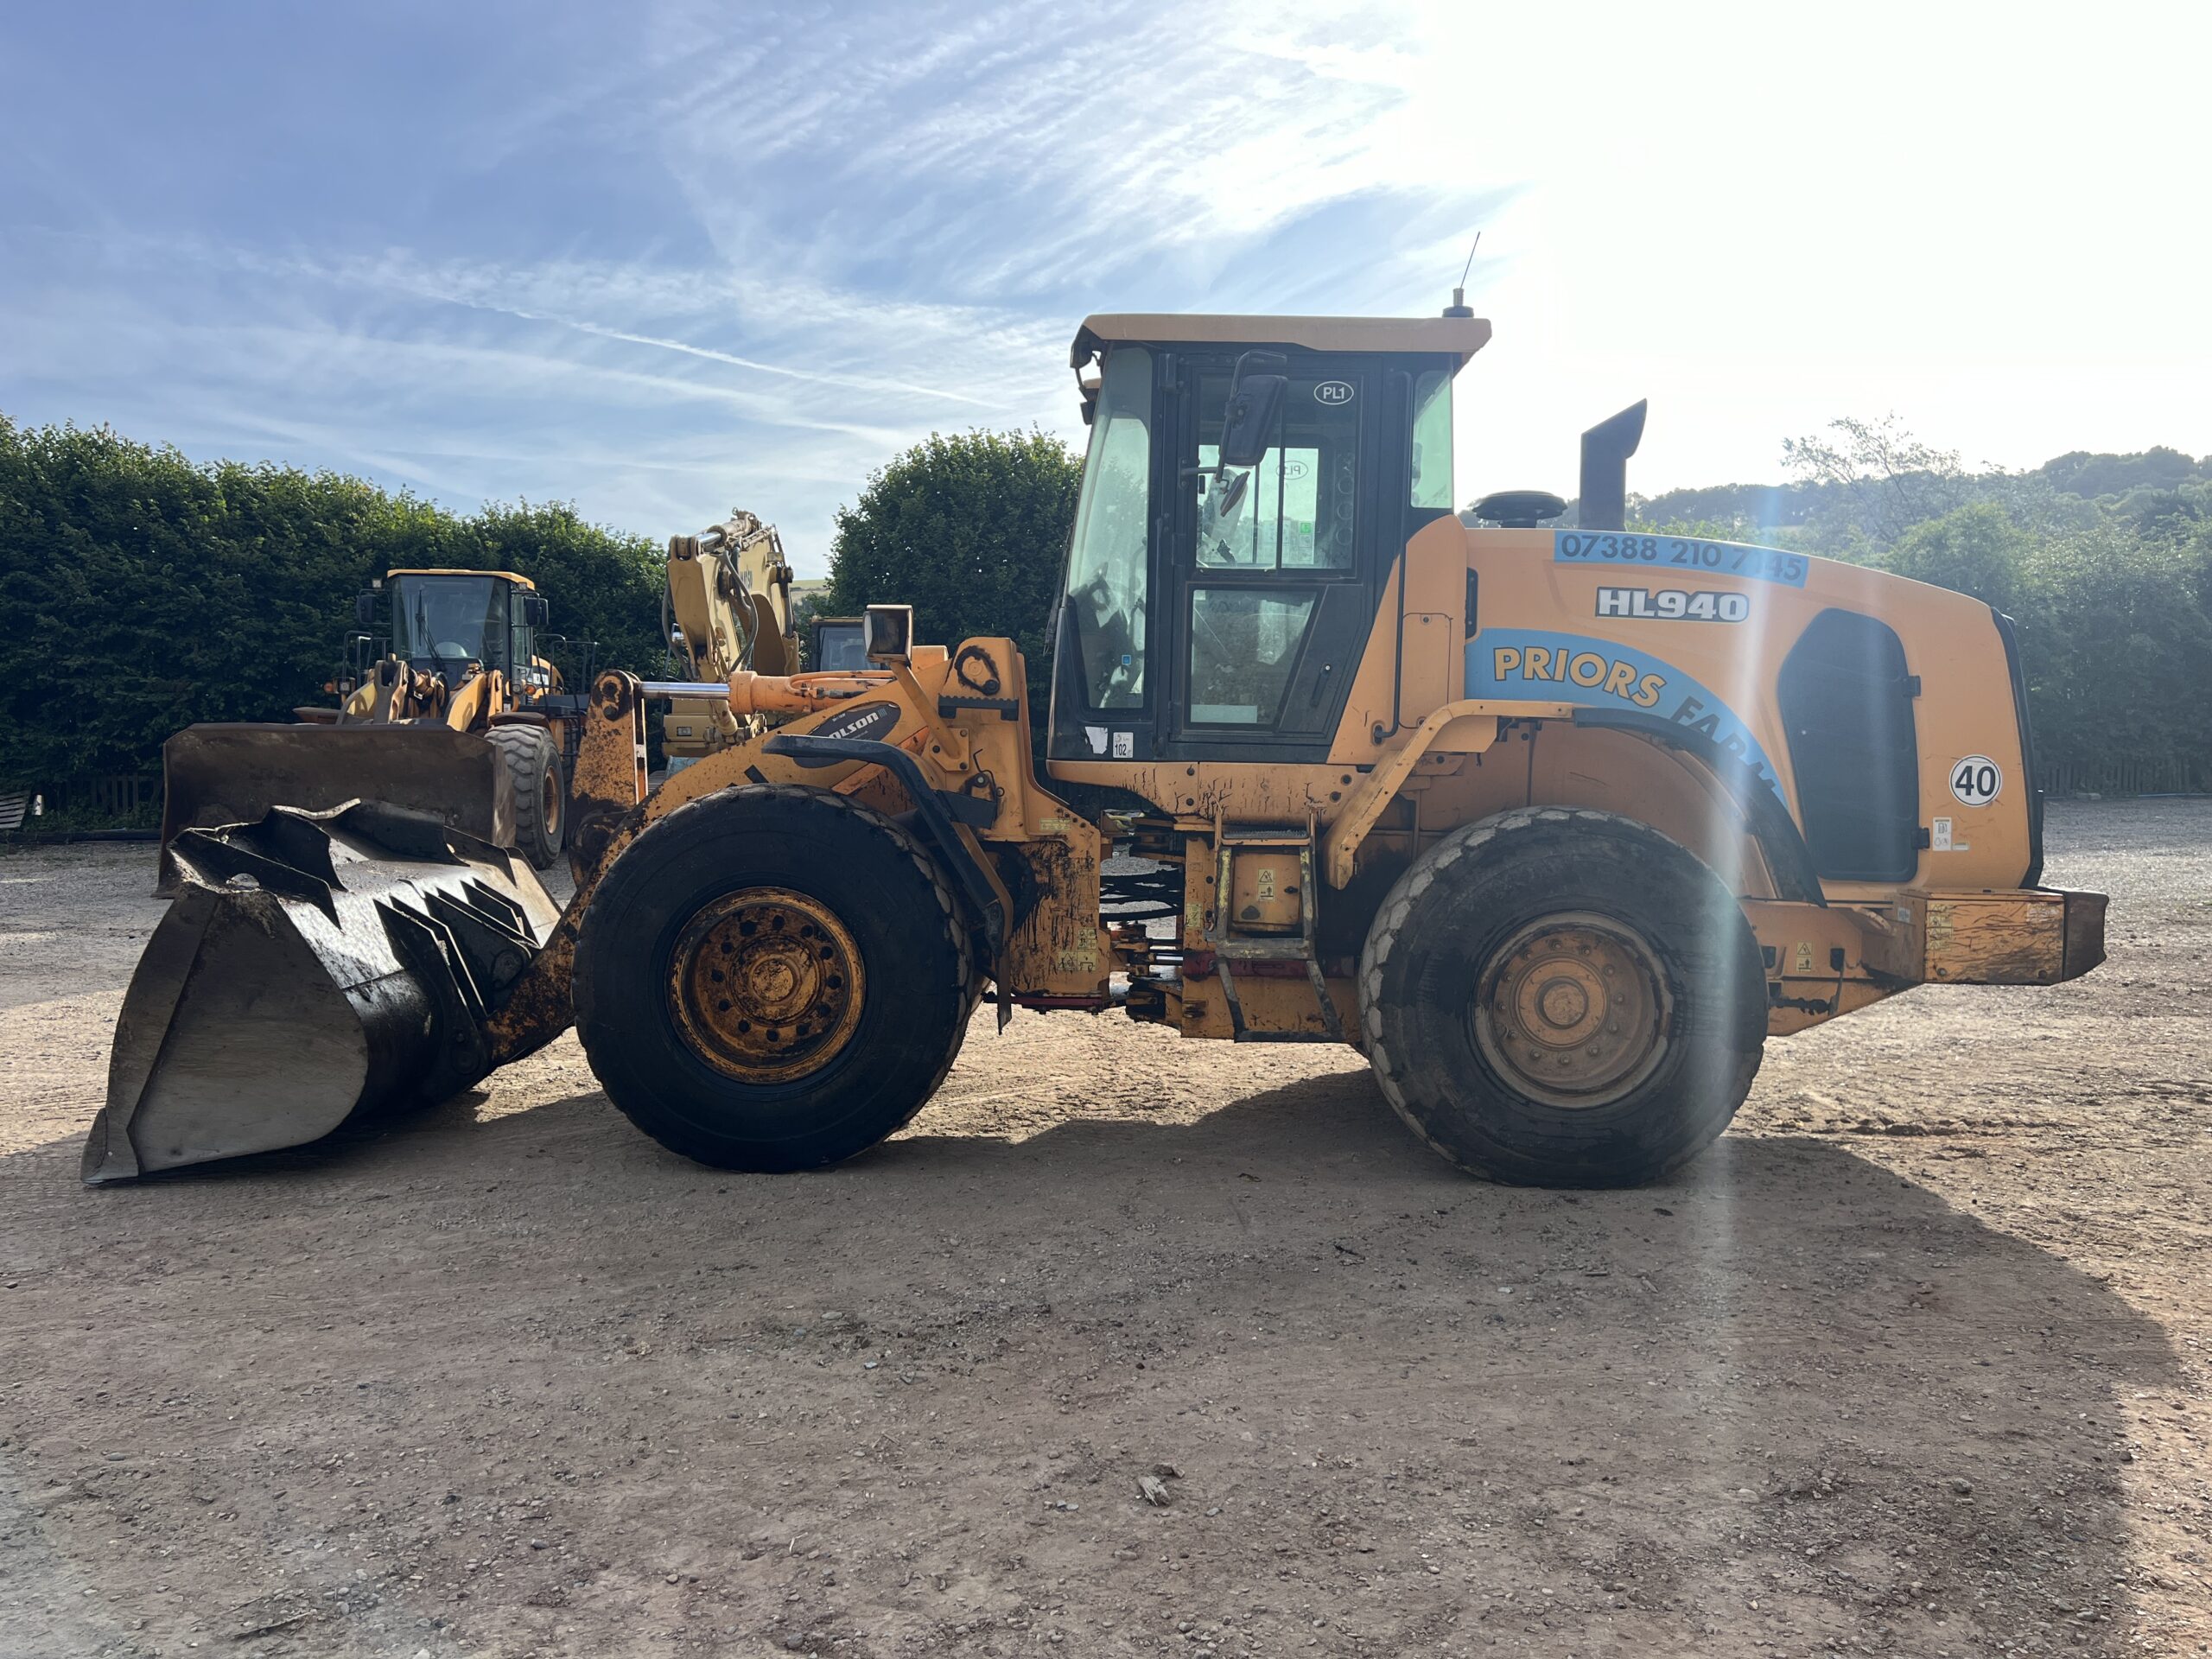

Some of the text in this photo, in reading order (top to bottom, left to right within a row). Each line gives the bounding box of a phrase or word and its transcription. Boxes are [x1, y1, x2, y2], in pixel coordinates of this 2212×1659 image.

[1323, 386, 1345, 399] PL1
[1560, 534, 1802, 582] 07388 210 745
[1596, 587, 1749, 623] HL940
[1493, 645, 1776, 790] PRIORS FAR
[1955, 766, 1996, 797] 40
